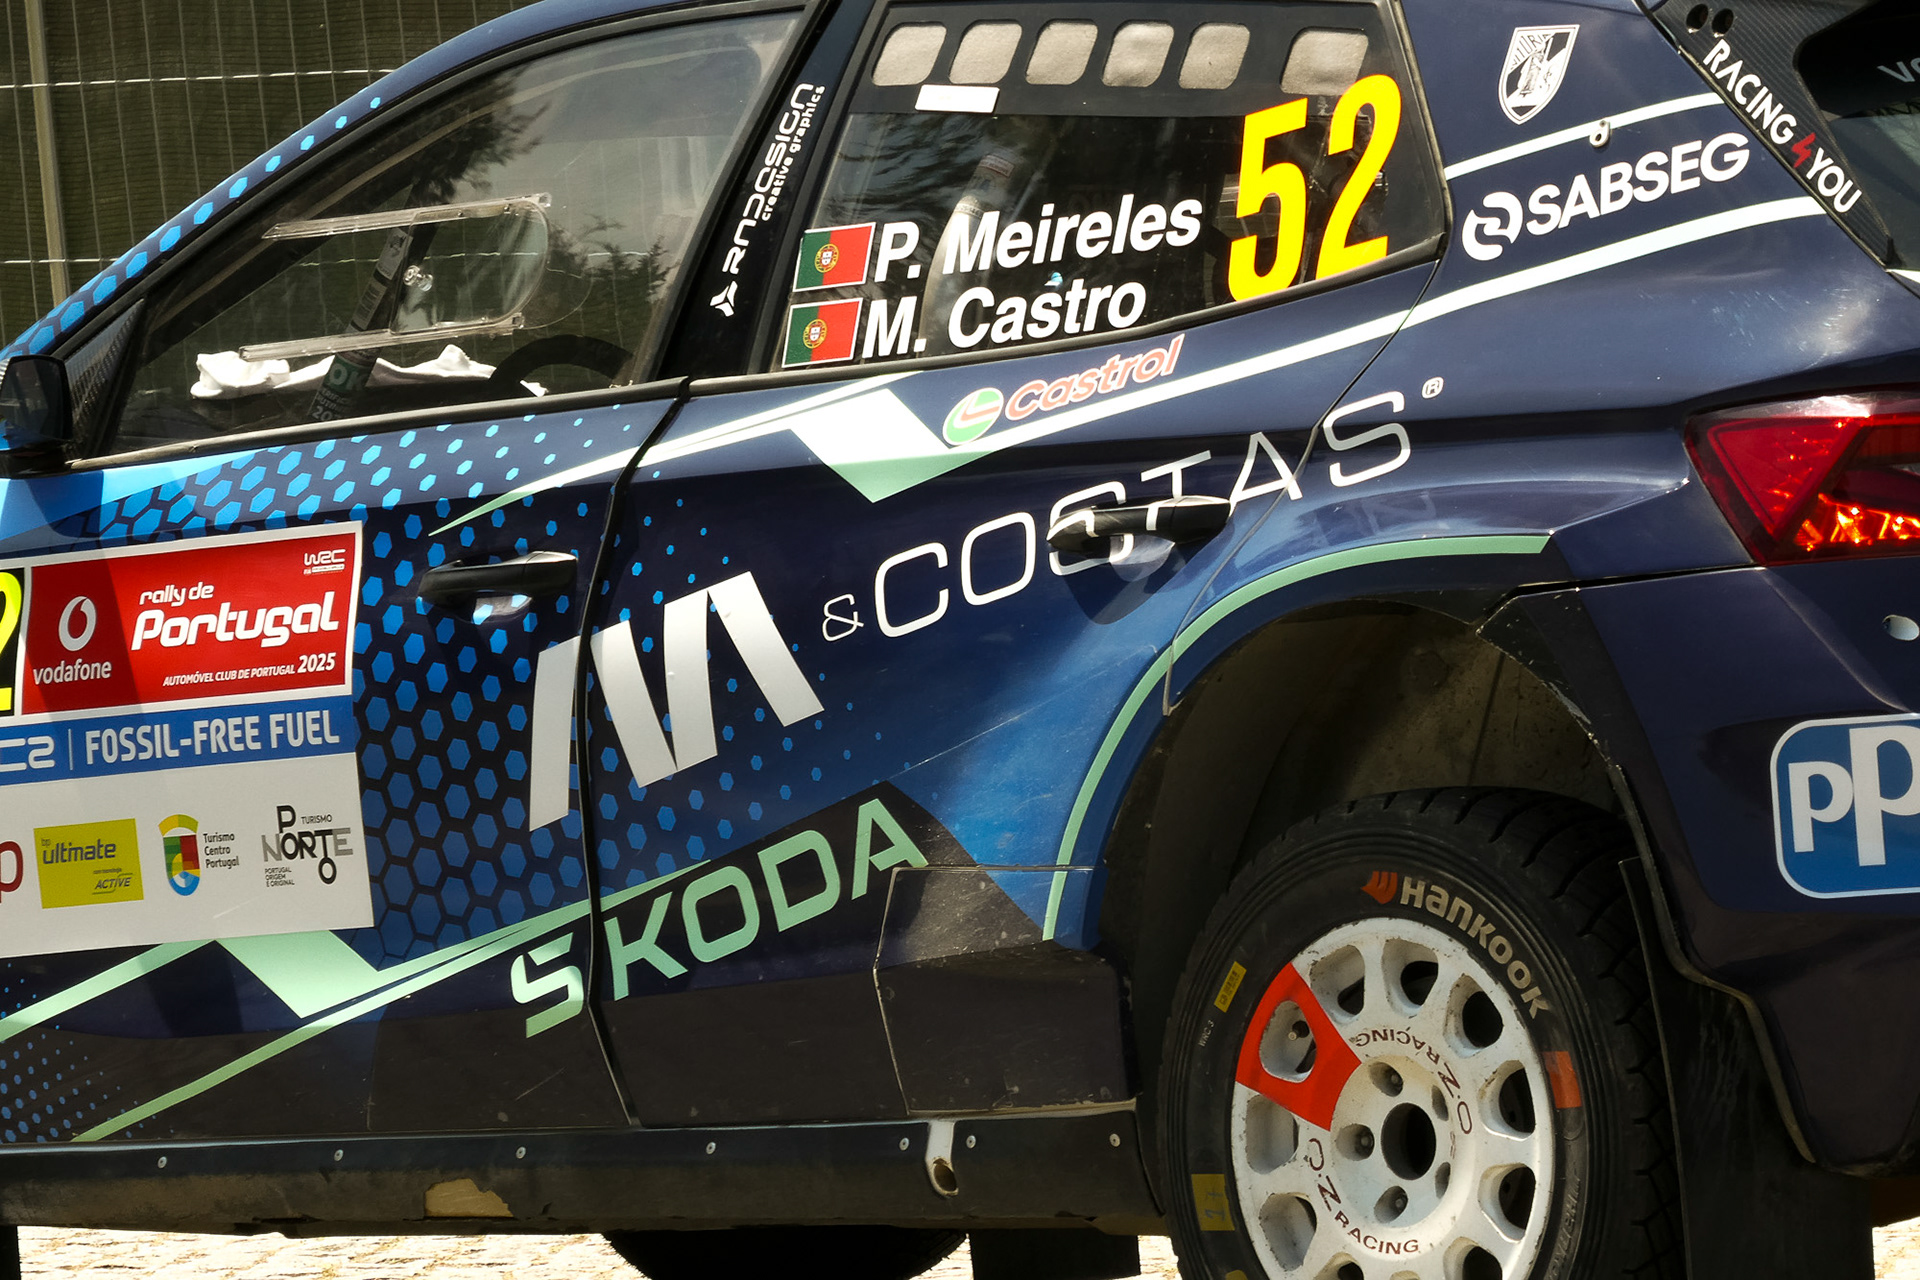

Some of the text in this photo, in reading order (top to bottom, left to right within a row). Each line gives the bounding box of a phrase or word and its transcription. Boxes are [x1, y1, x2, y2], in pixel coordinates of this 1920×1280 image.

[1703, 39, 1794, 145] RACING
[1806, 147, 1862, 213] YOU
[762, 85, 826, 222] creative graphics
[1227, 74, 1402, 303] 52
[1526, 132, 1750, 236] SABSEG
[874, 194, 1203, 283] P. Meireles
[862, 278, 1147, 359] M. Castro
[1005, 334, 1187, 421] Castrol
[303, 549, 346, 566] WRC
[139, 581, 215, 607] rally de
[131, 591, 340, 651] Portugal
[33, 658, 112, 686] vodafone
[163, 652, 337, 687] AUTOMÓVEL CLUB DE PORTUGAL 2025
[85, 714, 263, 765] FOSSIL-FREE
[269, 709, 341, 750] FUEL
[301, 814, 333, 825] TURISMO
[203, 831, 235, 844] Turismo
[204, 845, 231, 856] Centro
[42, 839, 117, 865] ultimate
[205, 855, 240, 870] Portugal
[94, 876, 132, 890] ACTIVE
[264, 866, 292, 875] PORTUGAL
[265, 873, 286, 881] ORIGEM
[270, 879, 295, 888] ORIGINAL
[1334, 1209, 1419, 1255] RACING
